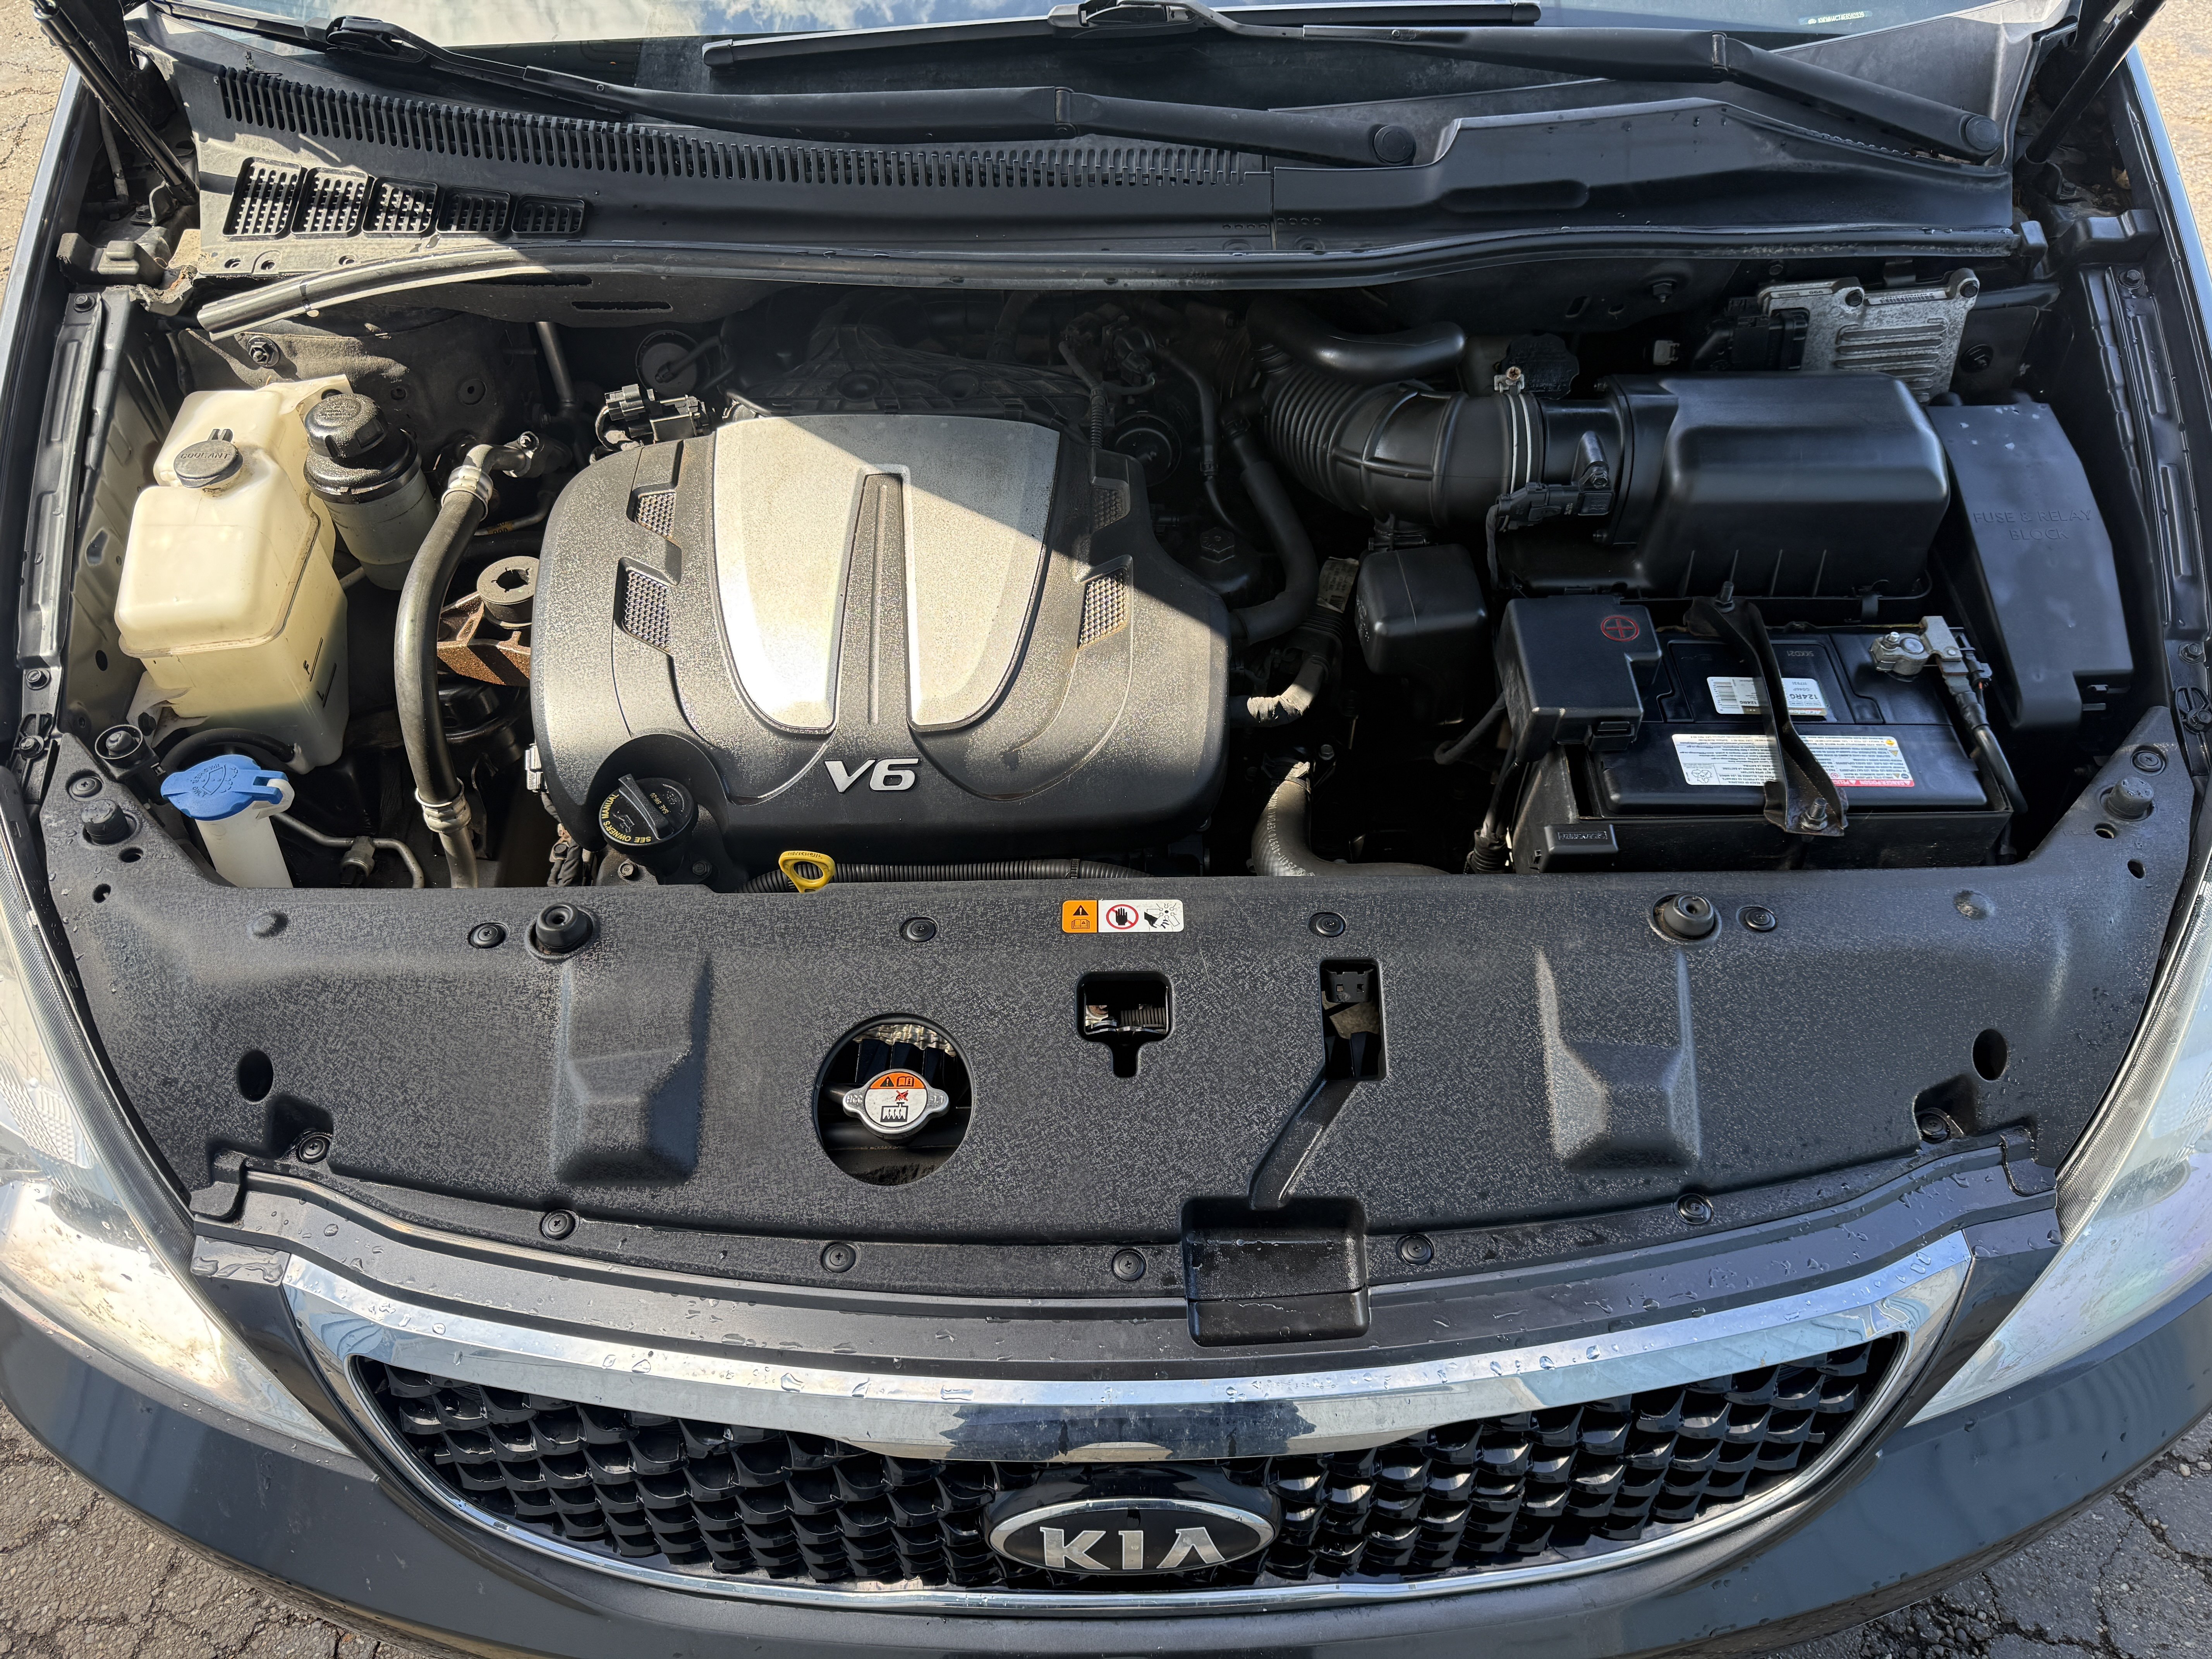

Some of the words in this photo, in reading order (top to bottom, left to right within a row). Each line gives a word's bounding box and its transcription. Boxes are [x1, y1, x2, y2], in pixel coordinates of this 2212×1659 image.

[1973, 512, 2016, 523] FUSE
[2020, 511, 2032, 521] &
[2037, 509, 2092, 521] RELAY
[2009, 528, 2069, 540] BLOCK
[824, 756, 921, 793] V6
[601, 794, 620, 819] MANUAL
[659, 804, 669, 814] SAE
[603, 820, 632, 842] OWNER'S
[1039, 1526, 1225, 1570] KIA
